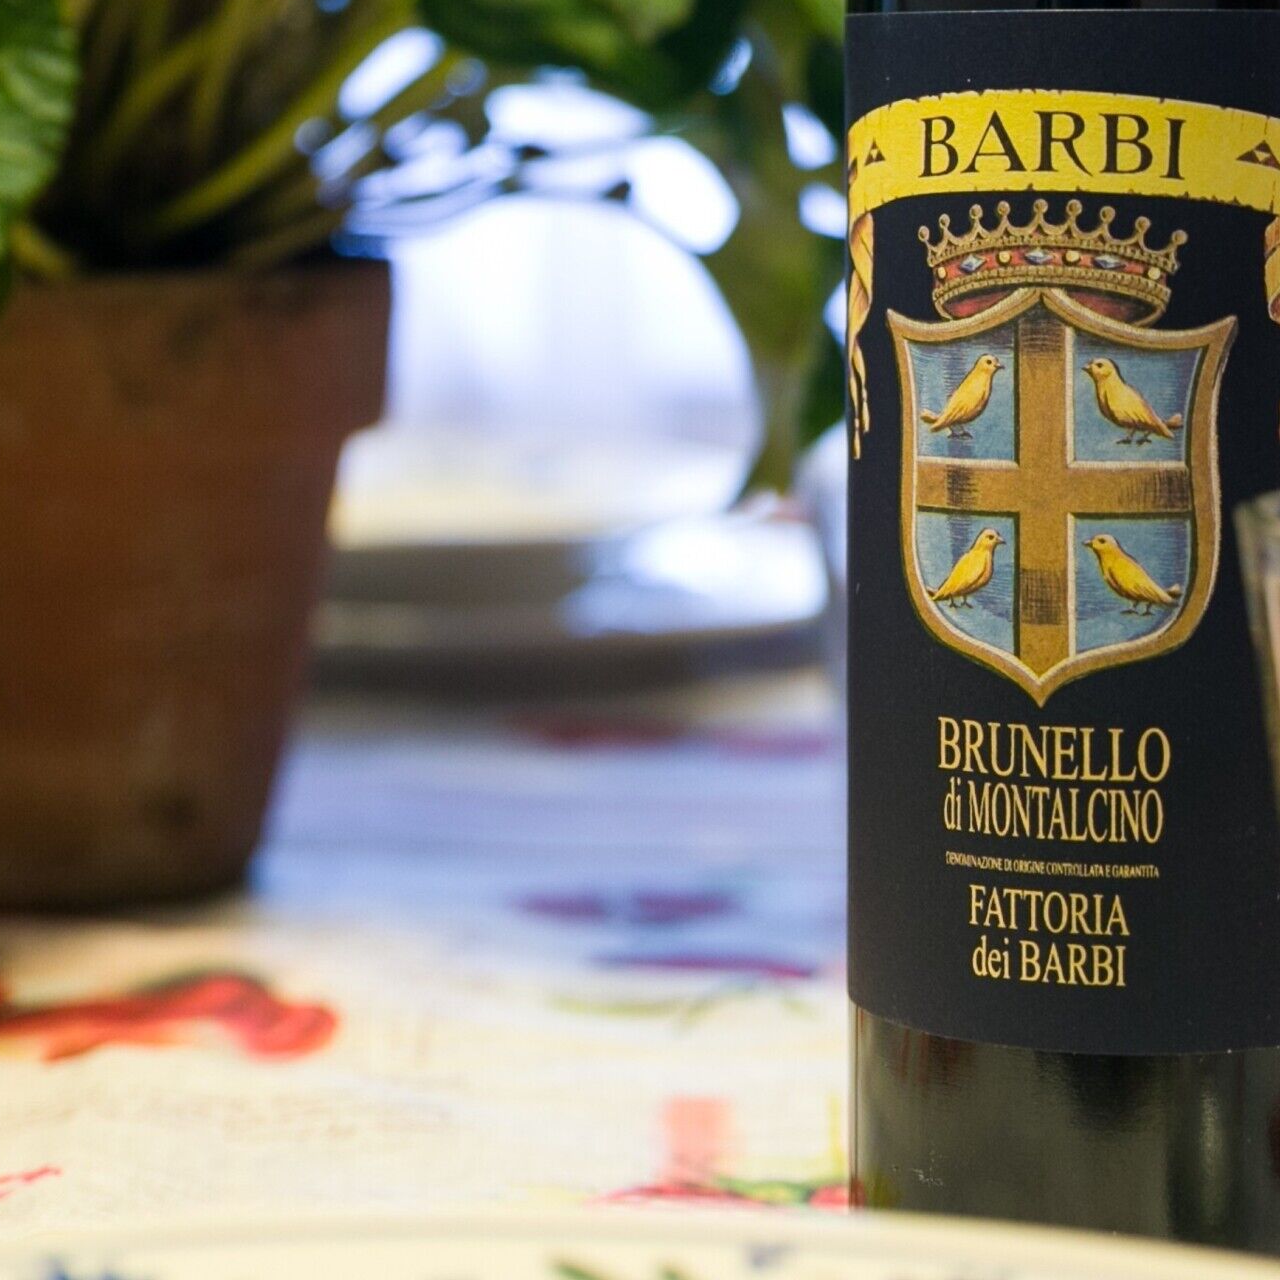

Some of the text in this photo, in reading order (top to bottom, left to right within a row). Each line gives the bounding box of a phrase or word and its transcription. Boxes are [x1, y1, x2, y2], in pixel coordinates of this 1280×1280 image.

[920, 110, 1184, 180] BARBI
[938, 716, 1171, 783] BRUNELLO
[944, 776, 1164, 844] di MONTALCINO
[1046, 862, 1104, 877] CONTROLLATA
[1105, 865, 1111, 877] E
[969, 884, 1130, 936] FATTORIA
[972, 935, 1126, 987] dei BARBI
